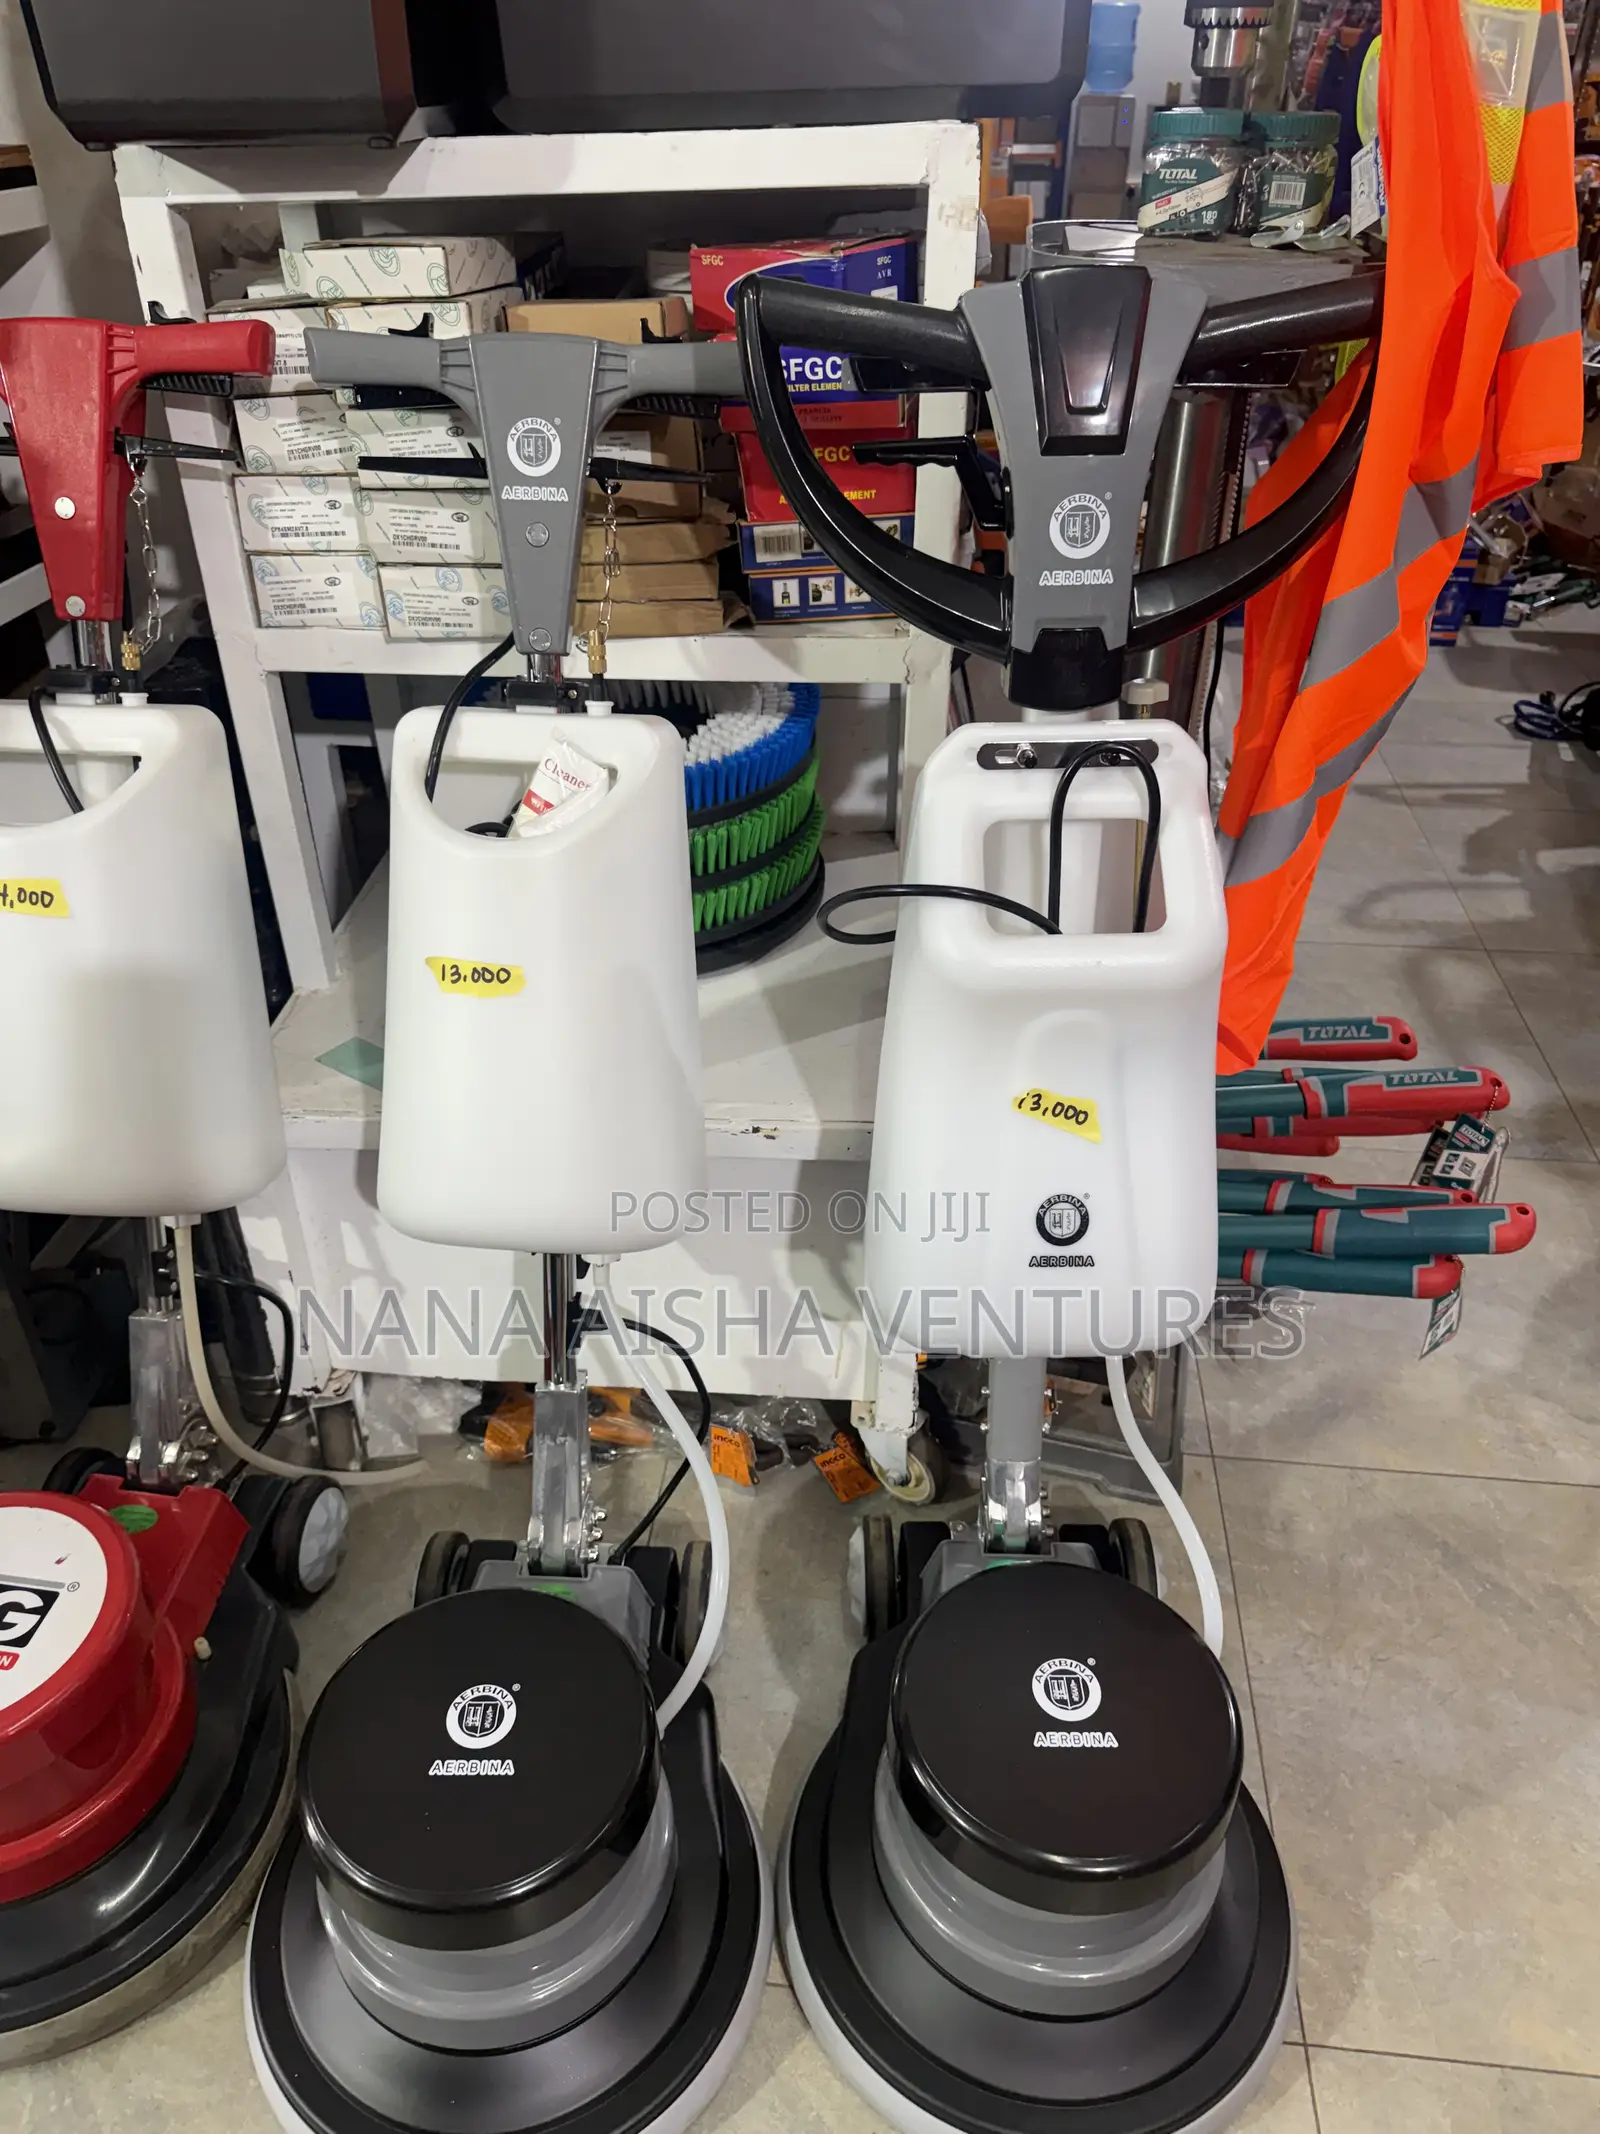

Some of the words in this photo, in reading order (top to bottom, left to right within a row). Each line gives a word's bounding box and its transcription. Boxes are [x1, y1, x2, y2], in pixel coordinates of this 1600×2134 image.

[1159, 168, 1198, 180] TOTAL
[1201, 210, 1218, 220] 180
[701, 255, 724, 266] SFGC
[876, 255, 892, 266] SFGC
[876, 269, 892, 279] AVR
[787, 384, 810, 392] ILTER
[811, 382, 842, 391] ELEMEN
[509, 418, 558, 442] AERBINA
[814, 446, 850, 462] FGC
[501, 485, 569, 502] AERBINA
[844, 490, 876, 500] EMENT
[1053, 495, 1107, 522] AERBINA
[1039, 569, 1114, 586] AERBINA
[544, 757, 593, 791] Cleaner
[1308, 1025, 1371, 1039] TOTAL
[1389, 1071, 1460, 1085] TOTAL
[1038, 1194, 1087, 1217] AERBINA
[1028, 1255, 1095, 1268] AERBINA
[1035, 1660, 1094, 1684] AERBINA
[453, 1686, 513, 1711] AERBINA
[1033, 1731, 1119, 1748] AERBINA
[428, 1759, 515, 1776] AERBINA
